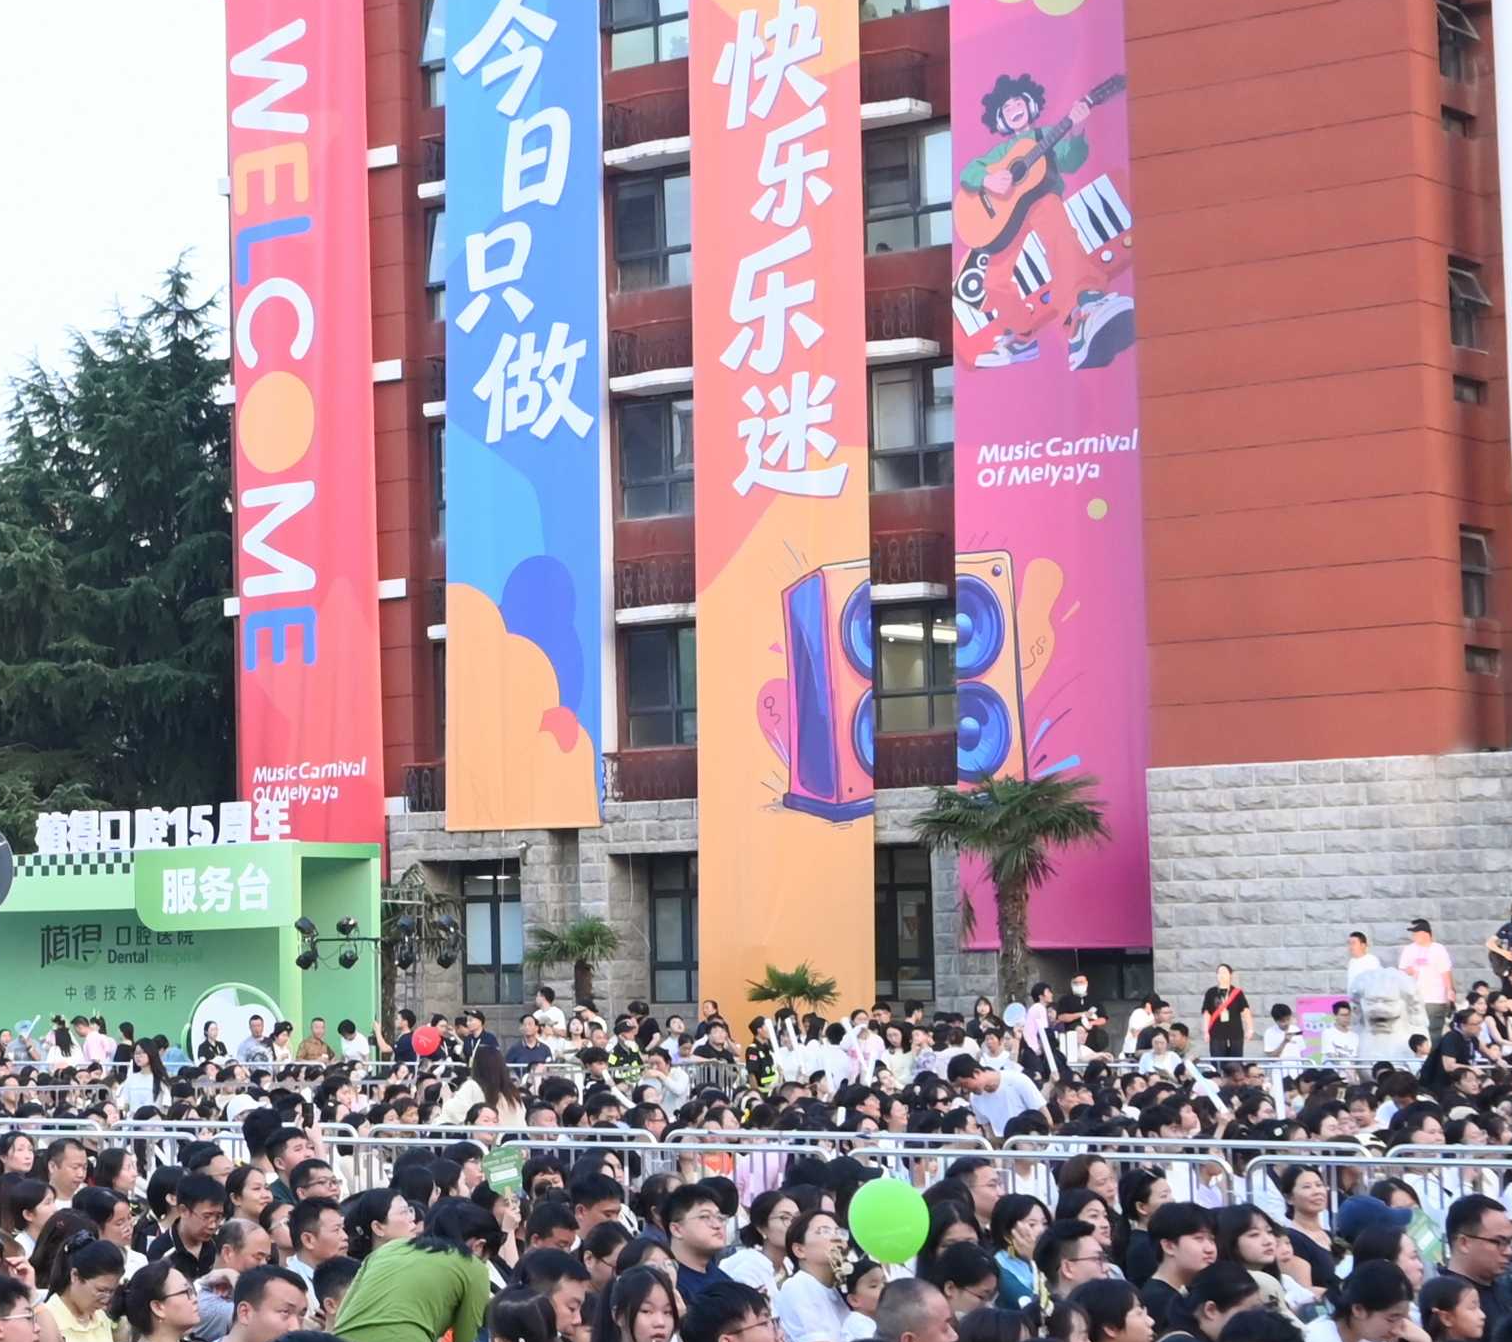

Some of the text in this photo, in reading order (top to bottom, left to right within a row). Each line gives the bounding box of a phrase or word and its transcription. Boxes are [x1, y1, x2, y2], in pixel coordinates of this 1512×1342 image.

[228, 19, 318, 671] WELCOME
[977, 428, 1138, 465] Music Carnival
[977, 465, 1006, 488] Of
[252, 756, 368, 784] Music Carnival
[161, 861, 272, 914] 服务台
[107, 948, 149, 964] Dental
[64, 984, 177, 1002] 中德技术合作
